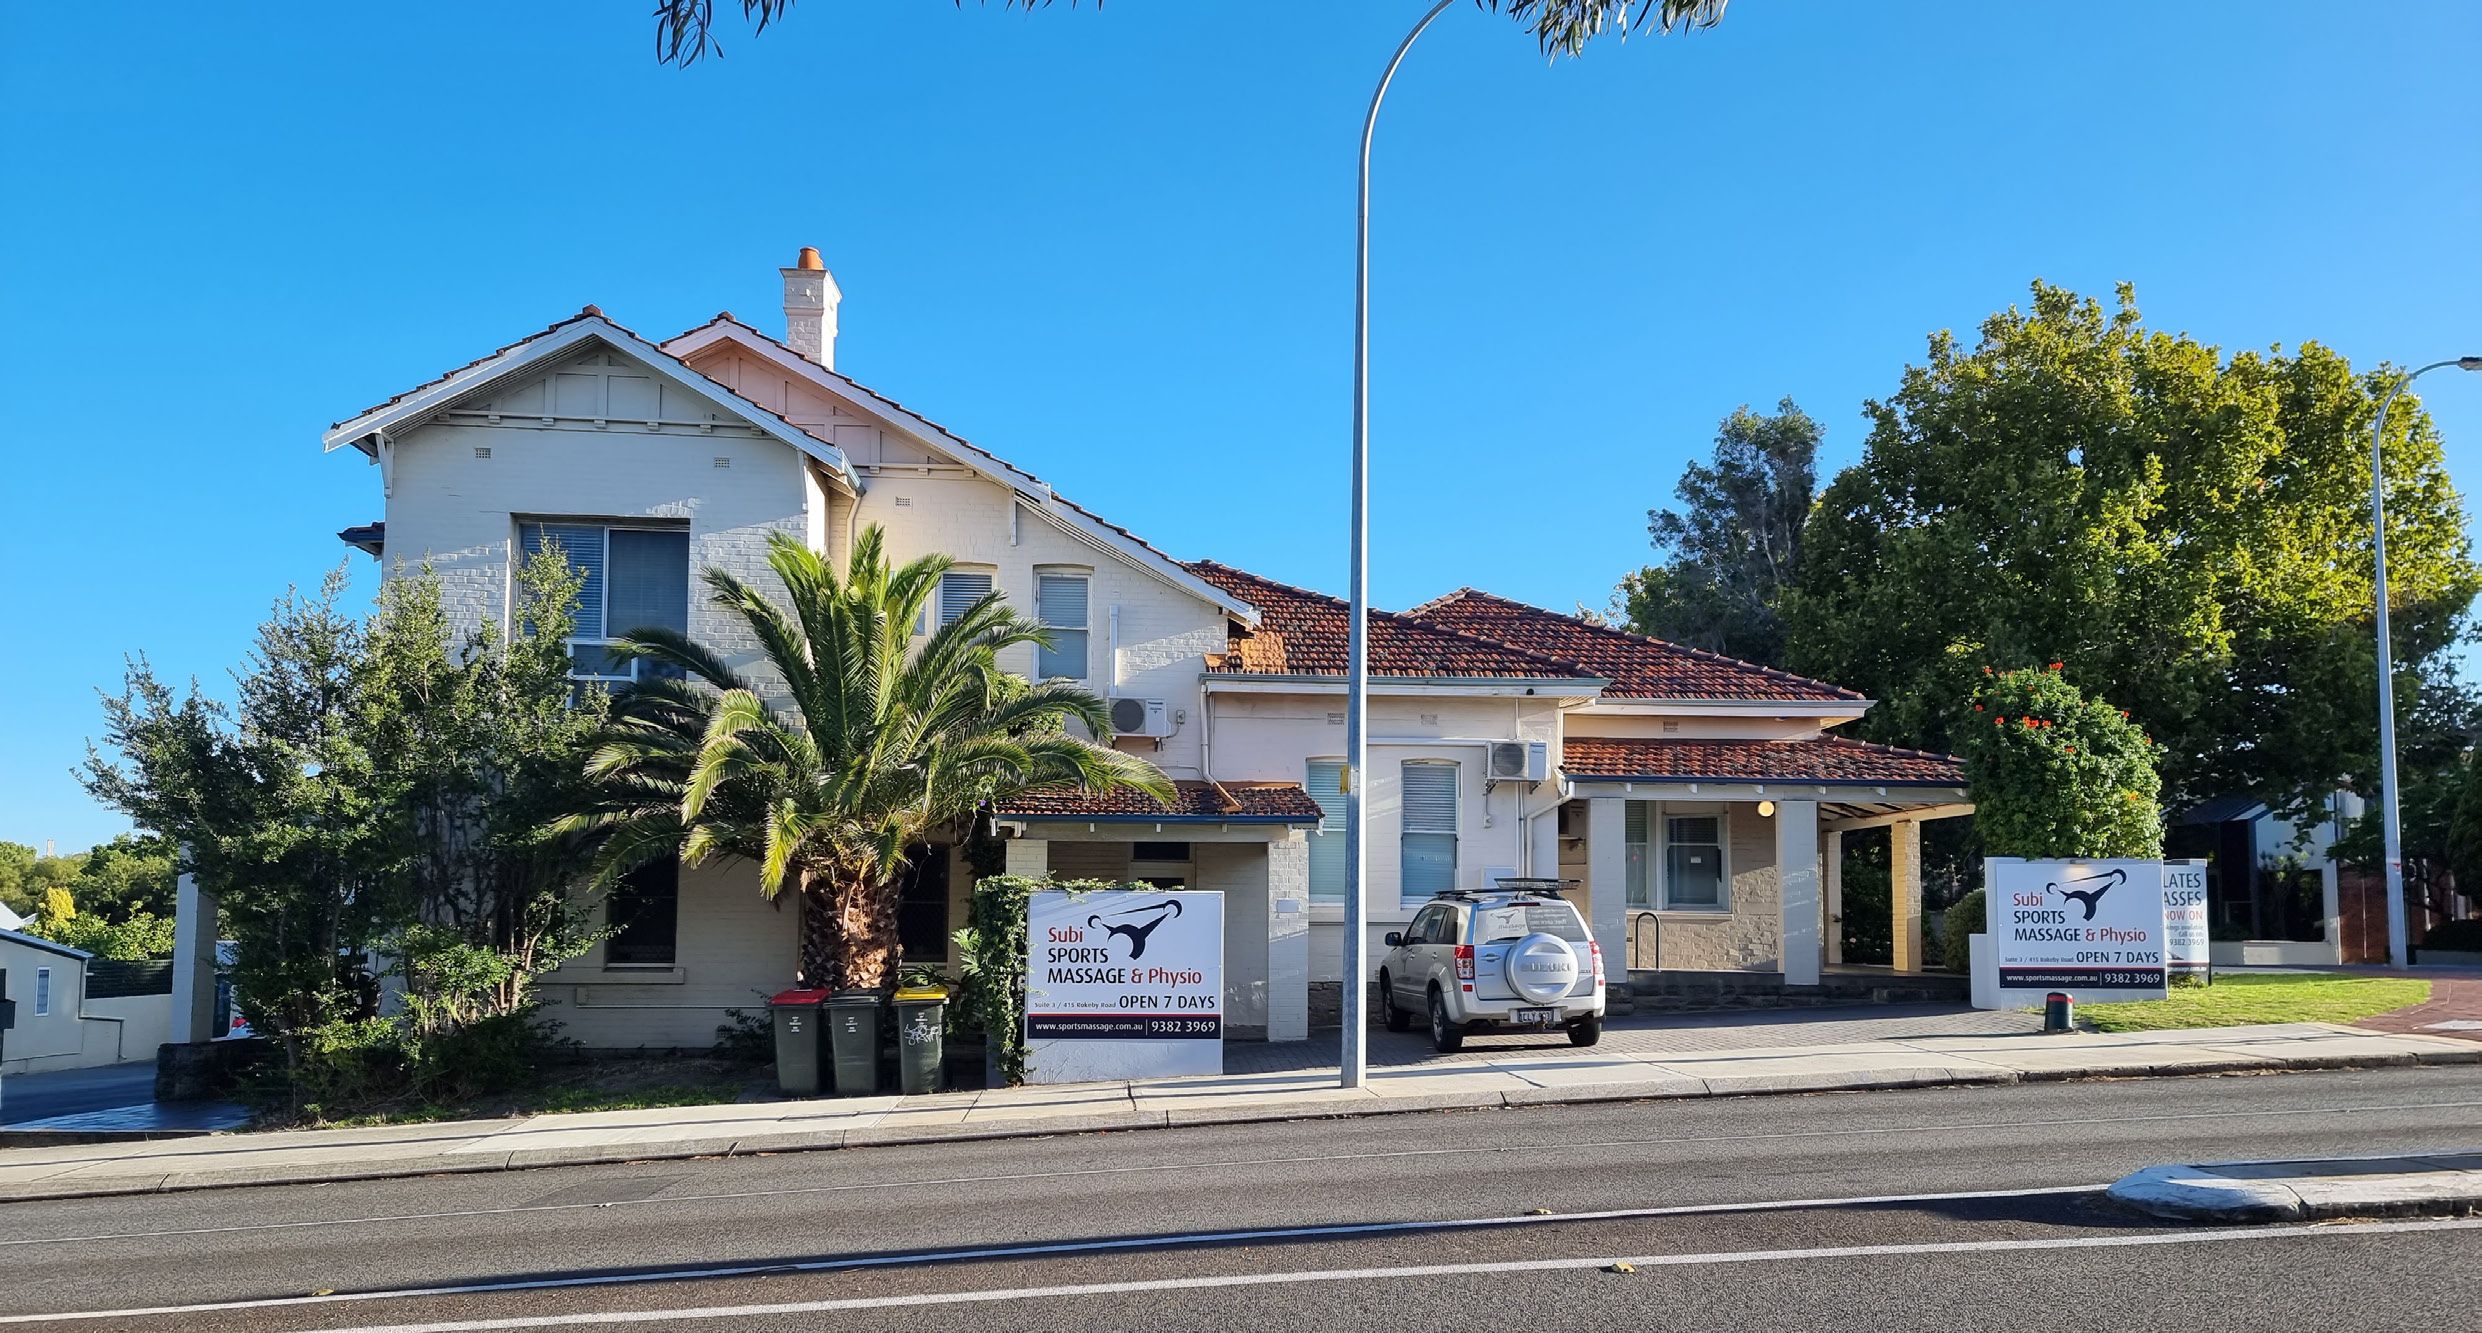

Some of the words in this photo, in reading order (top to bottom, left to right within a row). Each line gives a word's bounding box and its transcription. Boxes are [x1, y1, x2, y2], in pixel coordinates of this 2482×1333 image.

[2013, 892, 2043, 906] Subi
[2014, 910, 2065, 924] SPORTS
[2189, 911, 2203, 920] ON
[1048, 926, 1083, 943] Subi
[2014, 928, 2081, 942] MASSAGE
[2085, 928, 2095, 942] &
[2100, 927, 2146, 945] Physio
[1047, 948, 1109, 963] SPORTS
[2076, 951, 2110, 963] OPEN
[2114, 951, 2122, 963] 7
[2127, 951, 2159, 963] DAYS
[1047, 968, 1126, 984] MASSAGE
[1131, 968, 1143, 984] &
[1148, 967, 1202, 988] Physio
[2006, 974, 2098, 983] www.sportsmassage.com.au
[2105, 973, 2131, 983] 9382
[2134, 973, 2160, 984] 3969
[1077, 1001, 1099, 1009] Rokeby
[1119, 995, 1158, 1009] OPEN
[1164, 995, 1172, 1009] 7
[1177, 995, 1215, 1009] DAYS
[1035, 1022, 1143, 1032] www.sportsmassage.com.au
[1151, 1021, 1181, 1032] 9382
[1185, 1021, 1216, 1032] 3969
